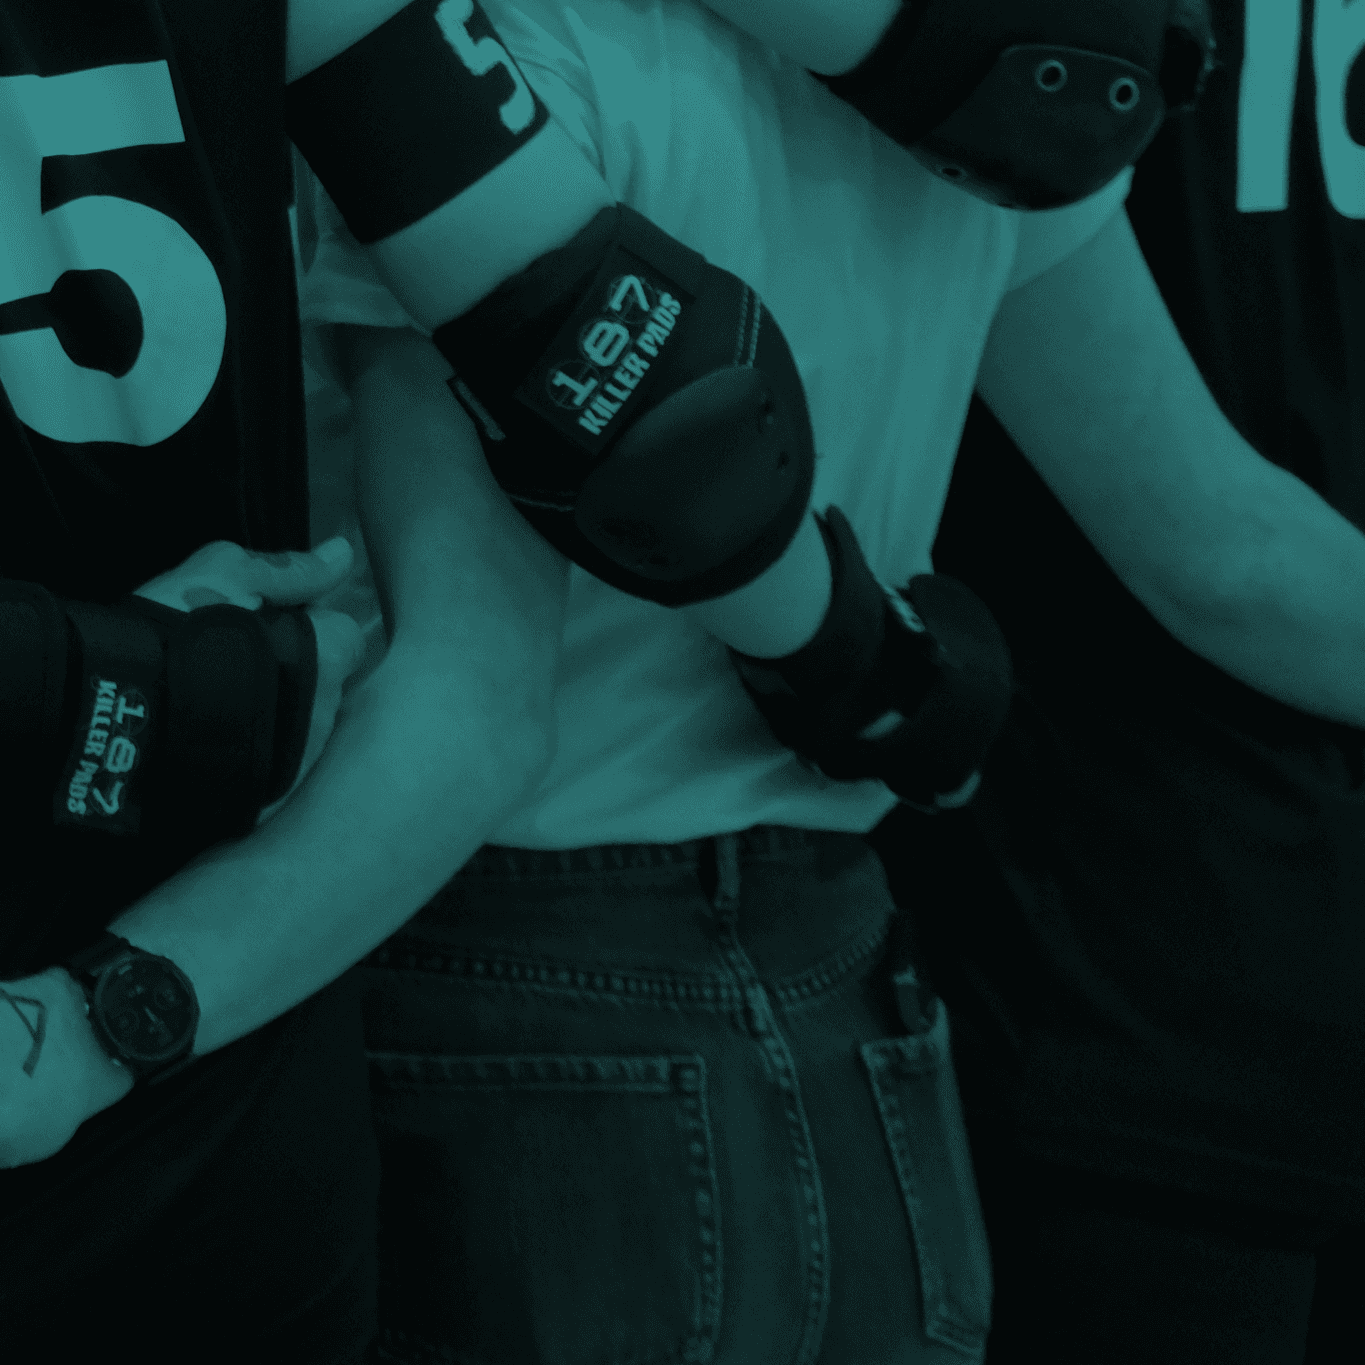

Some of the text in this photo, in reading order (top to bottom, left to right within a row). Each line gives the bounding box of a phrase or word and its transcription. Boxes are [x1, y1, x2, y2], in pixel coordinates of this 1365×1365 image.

[552, 274, 650, 407] 187
[578, 292, 682, 436] KILLER PADS
[84, 680, 118, 756] KILLER
[93, 695, 145, 815] 187
